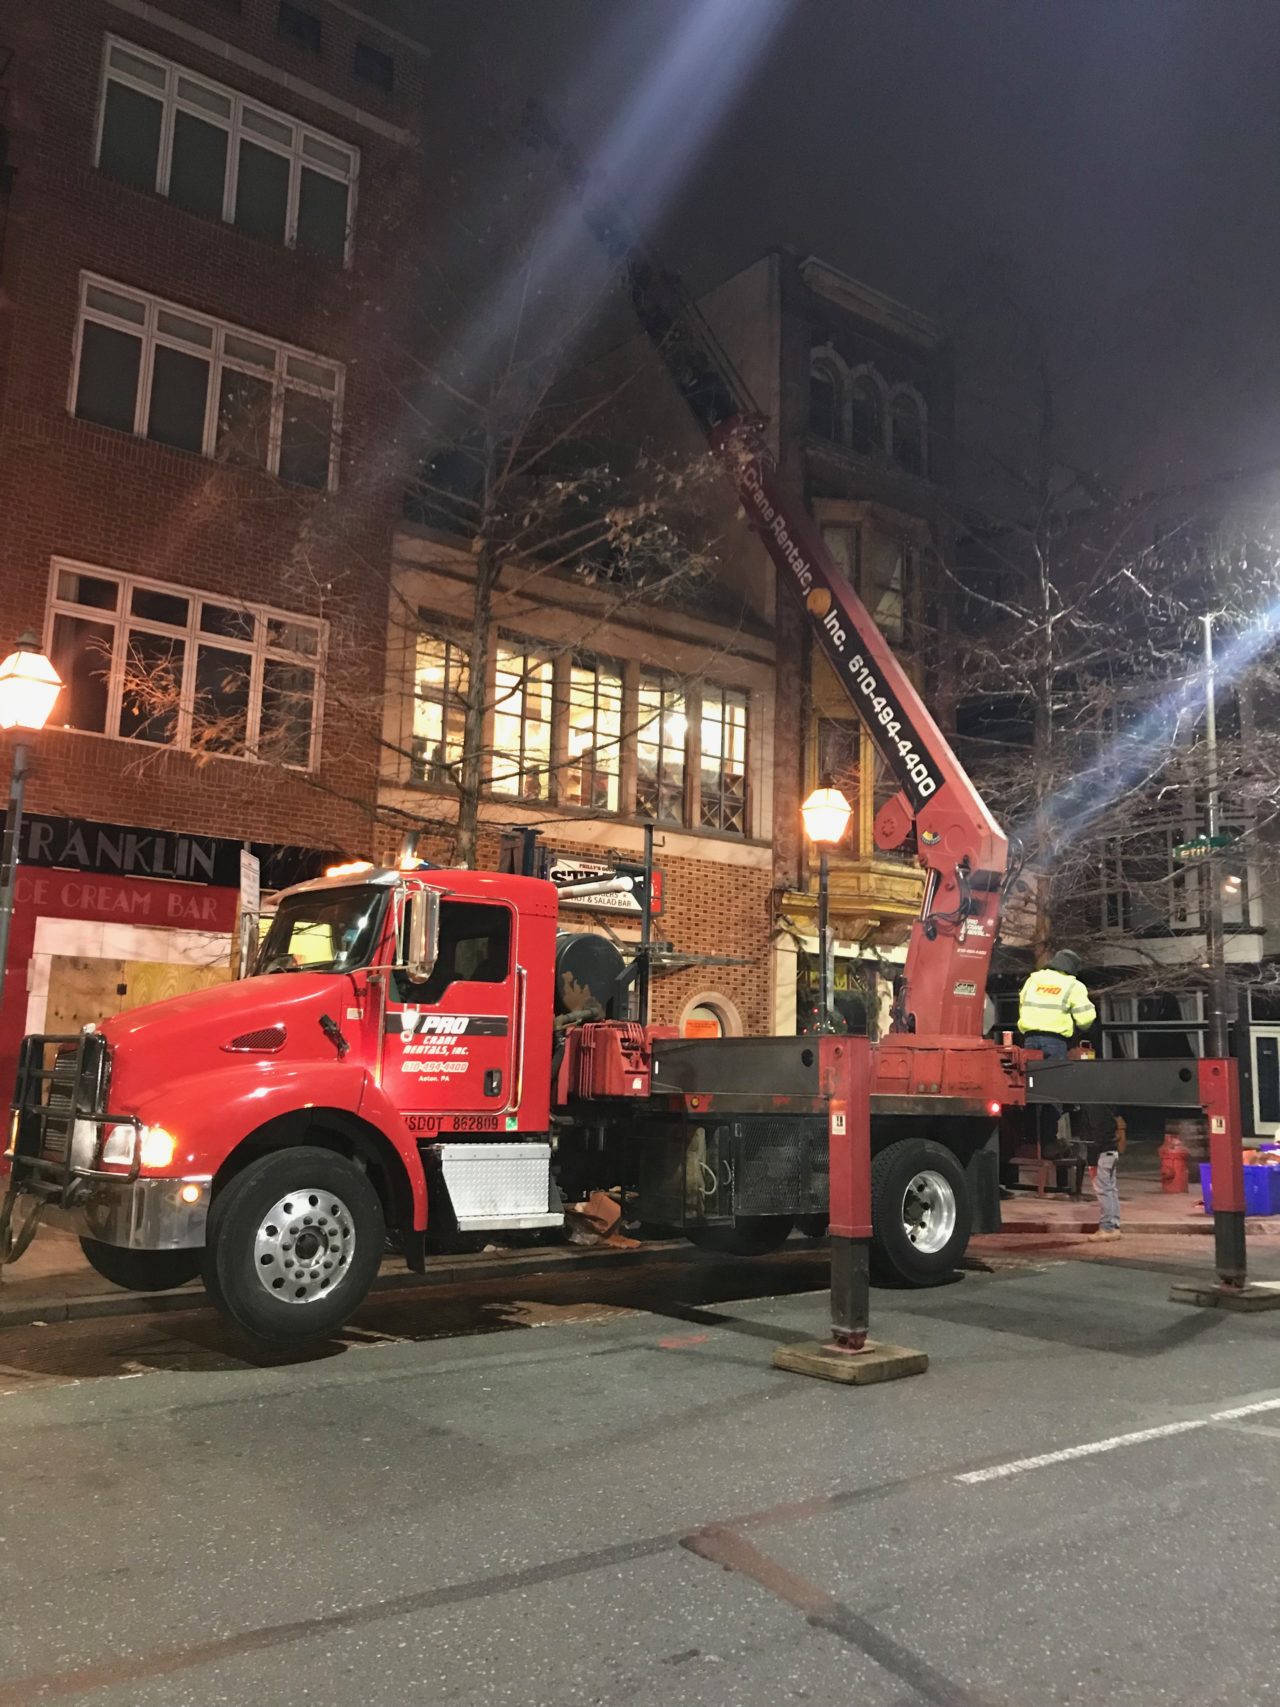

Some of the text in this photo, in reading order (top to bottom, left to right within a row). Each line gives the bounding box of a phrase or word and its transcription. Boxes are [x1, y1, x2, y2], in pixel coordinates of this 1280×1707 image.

[744, 467, 775, 521] Crane
[823, 608, 846, 653] Inc.
[848, 655, 937, 798] 610-494-4400
[15, 877, 217, 921] CE CREAM BAR
[594, 896, 617, 906] SALAD
[618, 899, 632, 907] BAR
[420, 1016, 470, 1034] PRO
[423, 1036, 458, 1046] CRANE
[451, 1047, 469, 1055] INC.
[401, 1061, 469, 1073] 610-494-4400
[453, 1115, 499, 1131] 862809
